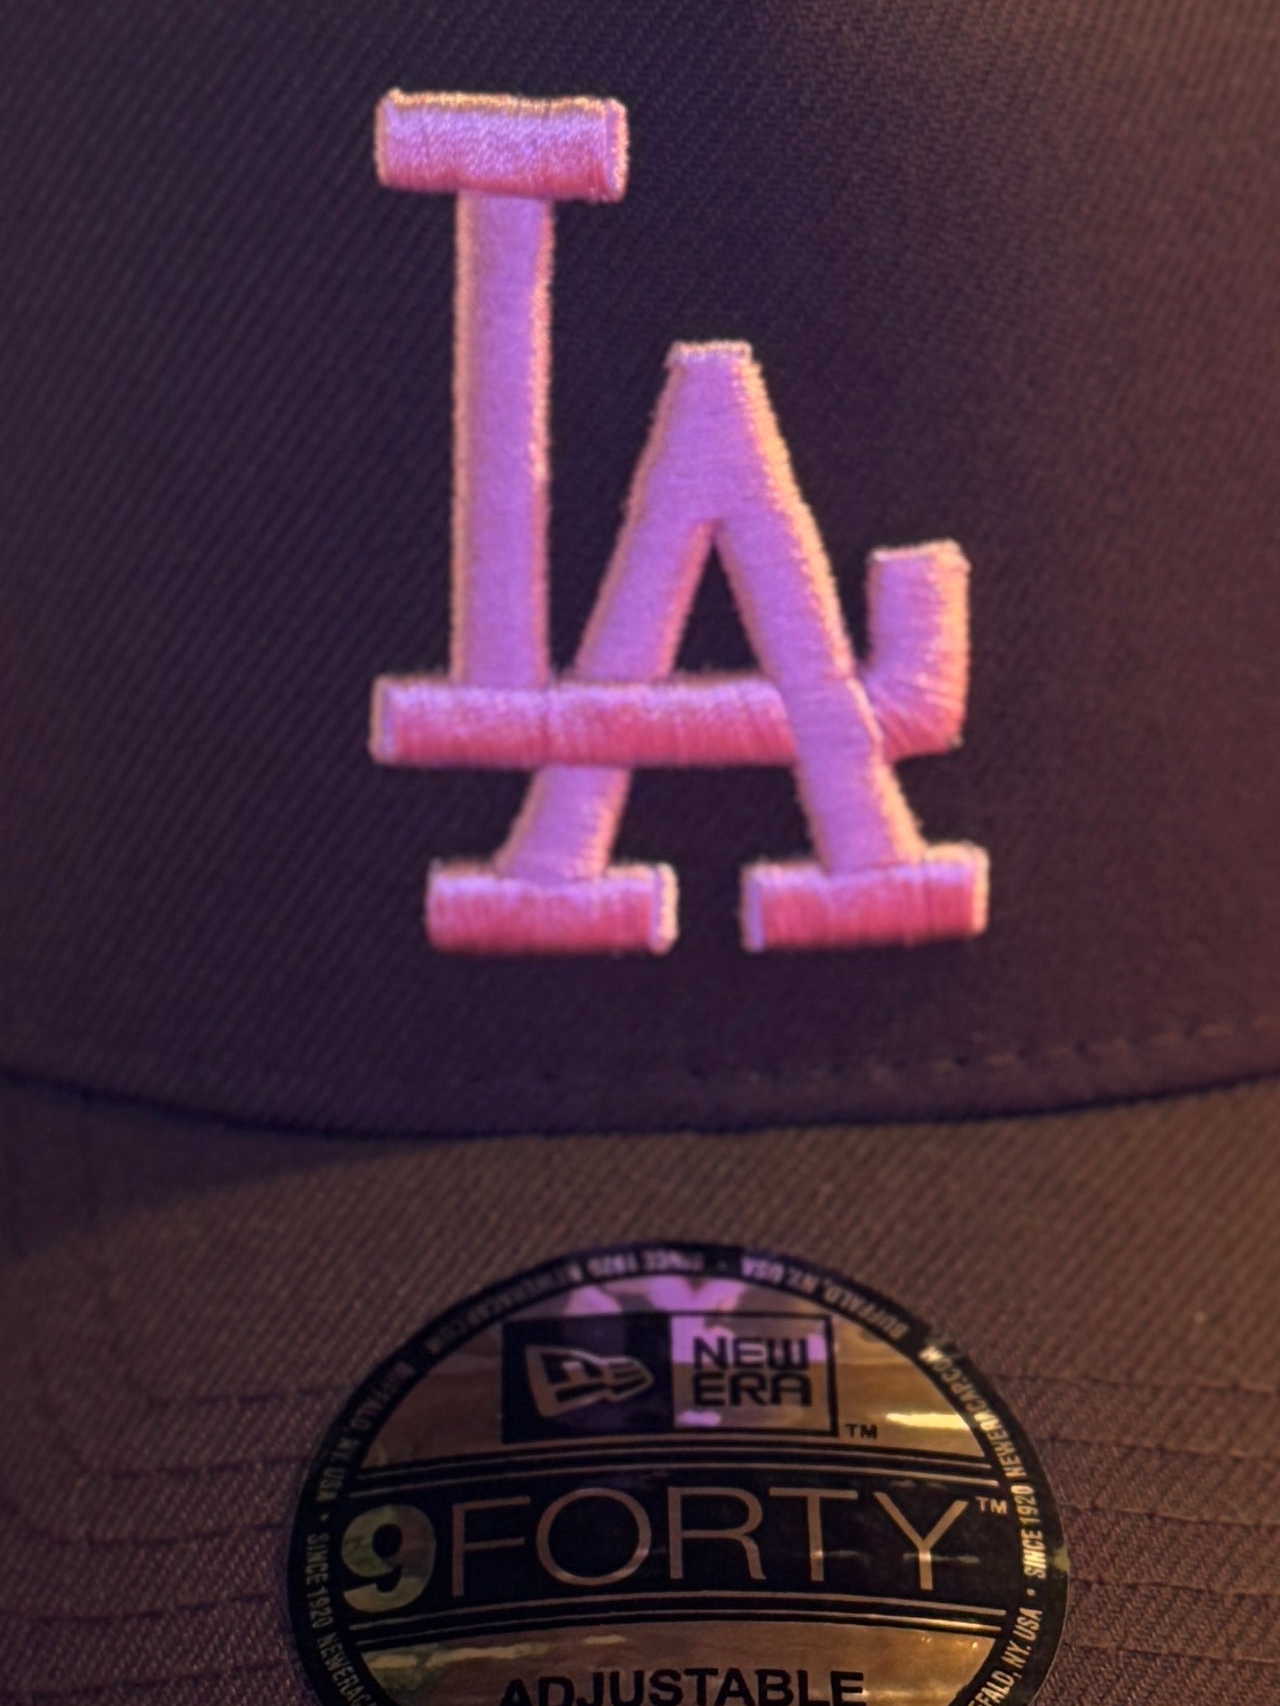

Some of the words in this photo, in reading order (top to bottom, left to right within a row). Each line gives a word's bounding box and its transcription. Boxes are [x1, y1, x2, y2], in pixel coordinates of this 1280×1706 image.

[369, 89, 989, 953] LA
[692, 1336, 811, 1372] NEW
[691, 1372, 812, 1408] ERA
[1010, 1484, 1044, 1525] 1920
[341, 1486, 969, 1613] 9FORTY
[1020, 1527, 1047, 1579] SINCE
[1013, 1607, 1044, 1642] USA
